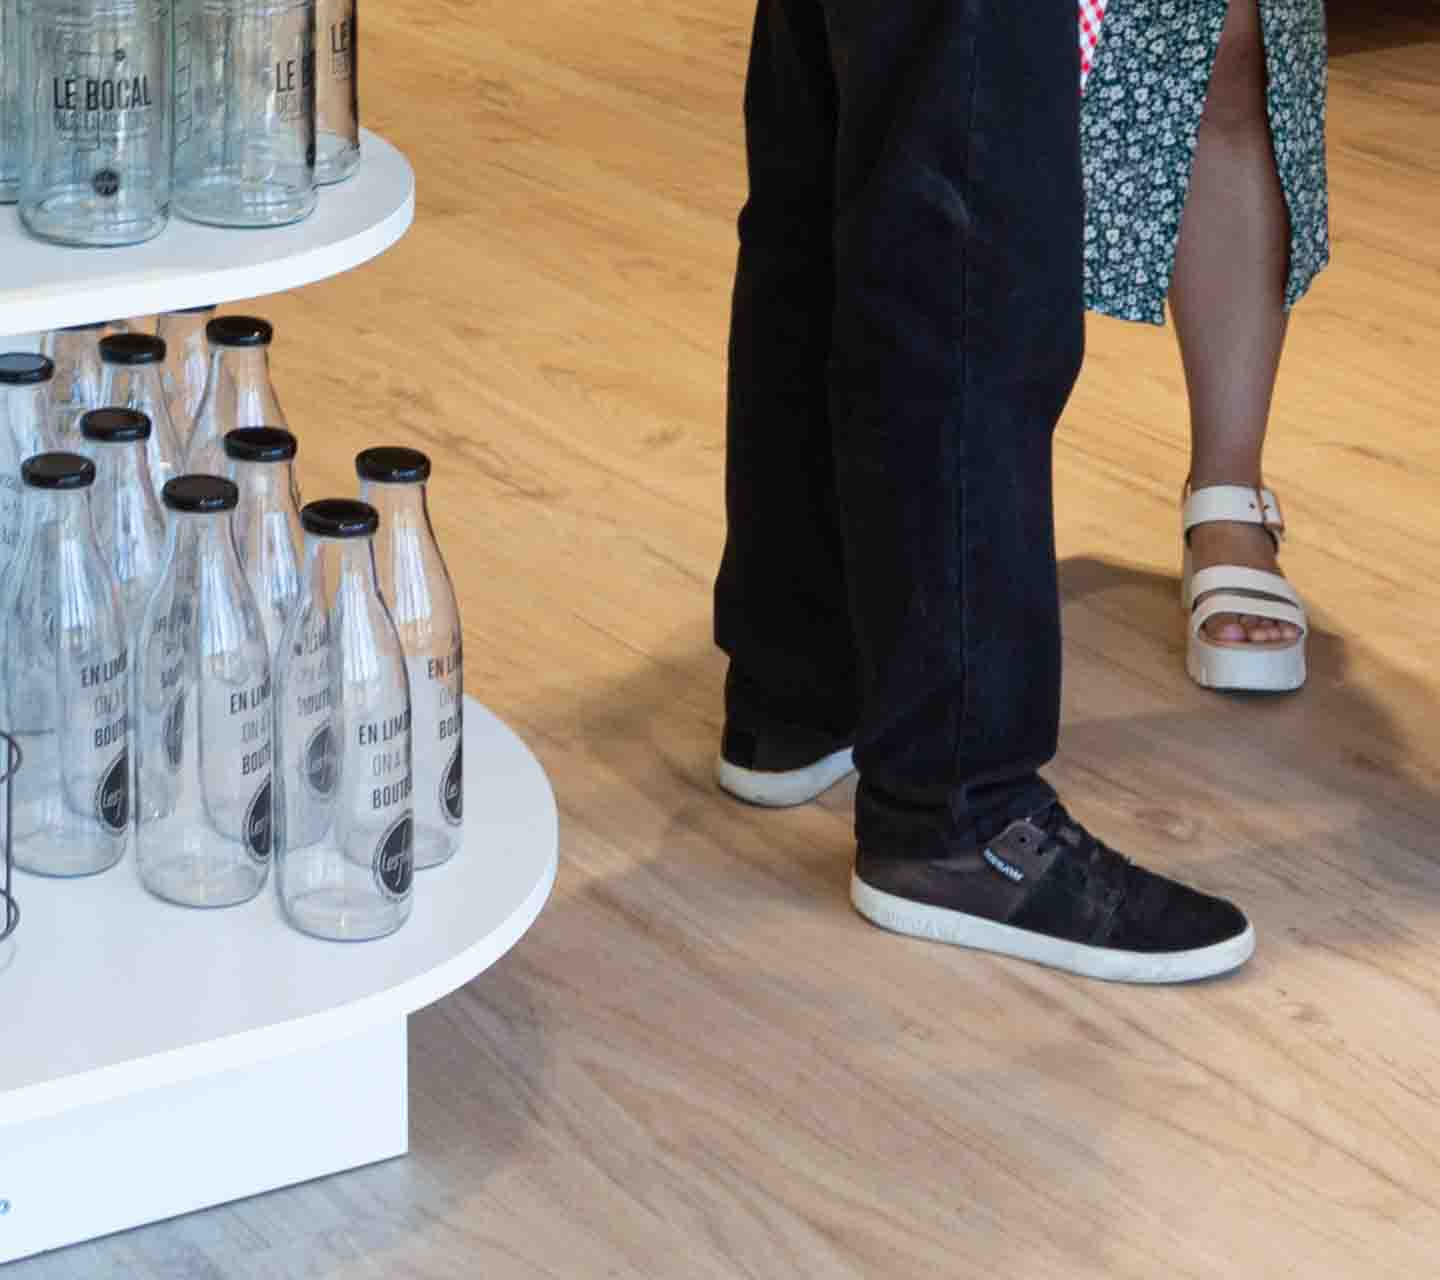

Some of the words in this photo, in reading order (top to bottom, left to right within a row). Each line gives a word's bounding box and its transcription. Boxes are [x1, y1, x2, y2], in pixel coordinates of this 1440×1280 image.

[53, 76, 77, 110] LE
[86, 74, 152, 111] BOCAL
[359, 722, 378, 746] EN
